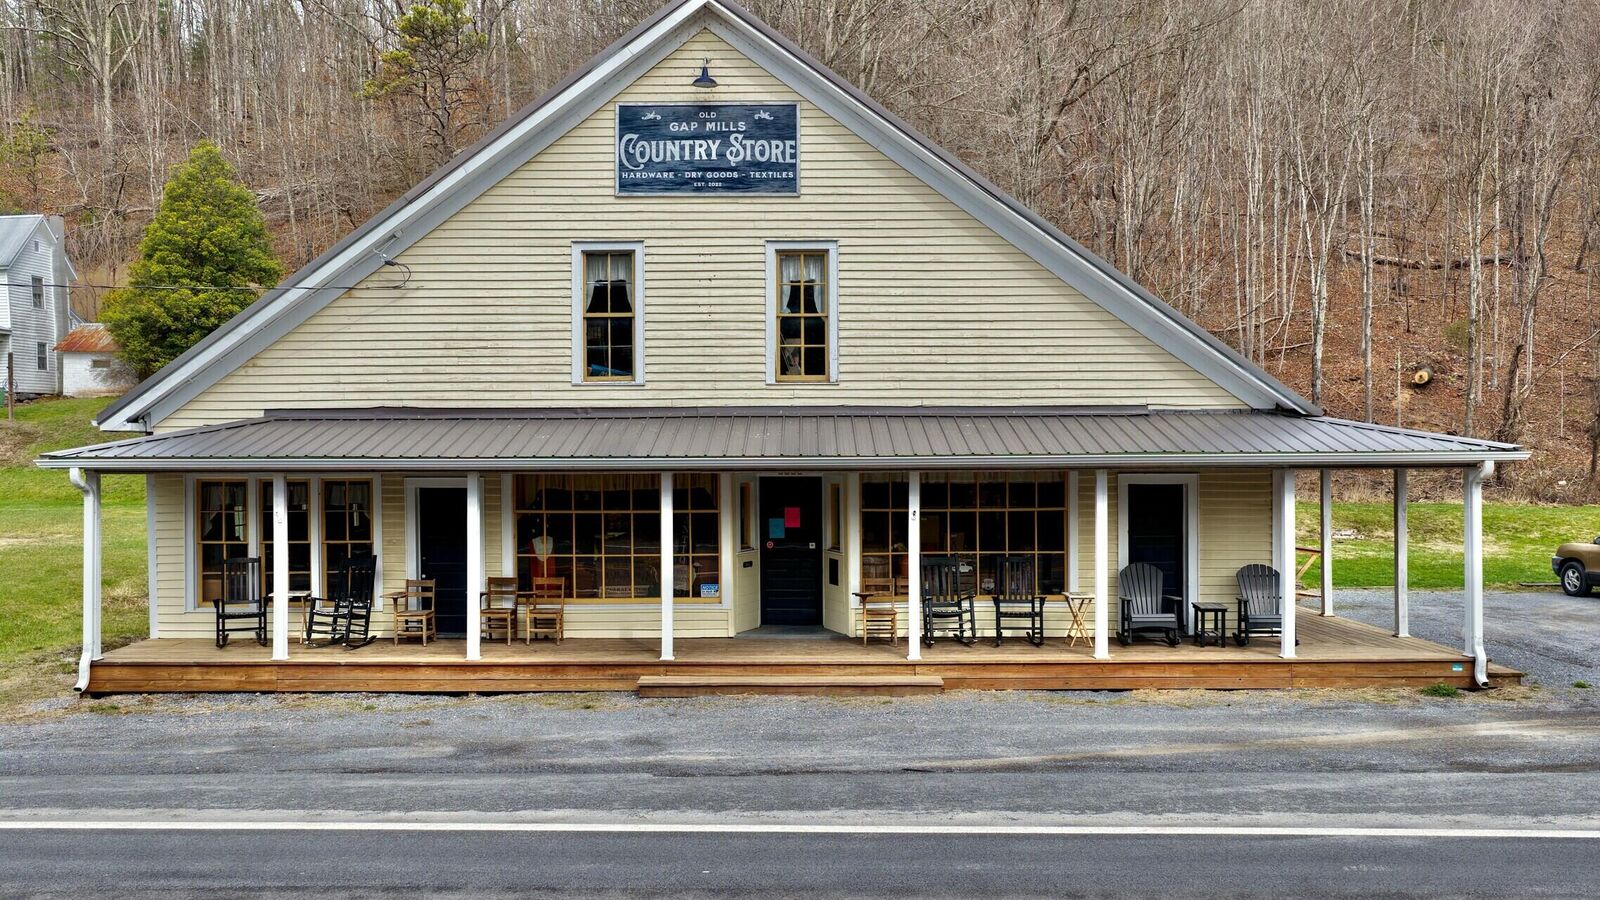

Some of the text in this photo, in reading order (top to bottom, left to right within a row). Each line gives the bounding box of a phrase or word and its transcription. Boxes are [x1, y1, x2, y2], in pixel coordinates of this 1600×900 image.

[670, 122, 746, 131] GAP MILLS
[620, 133, 796, 170] COUNTRY STORE
